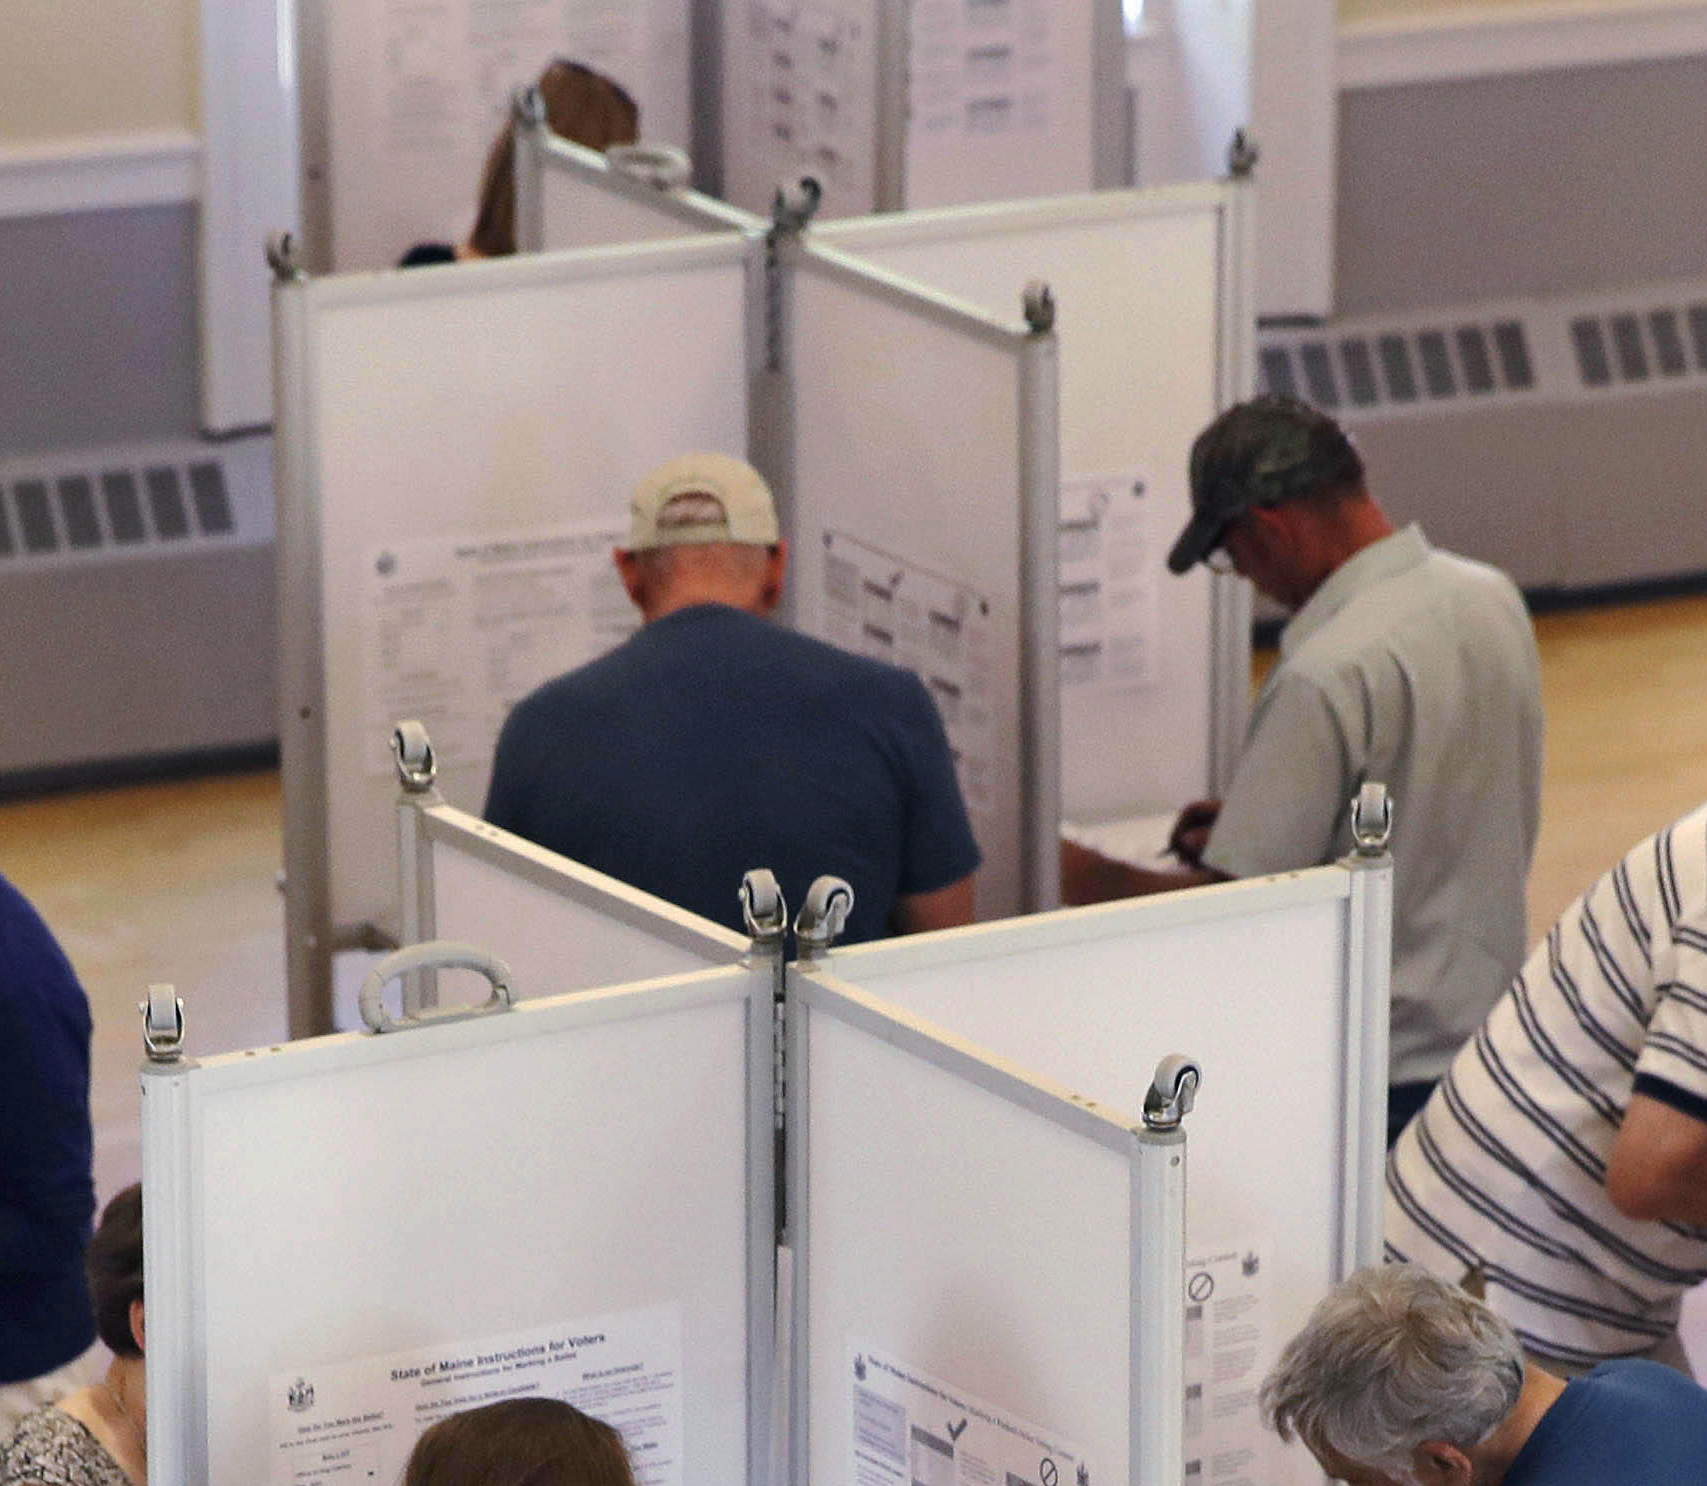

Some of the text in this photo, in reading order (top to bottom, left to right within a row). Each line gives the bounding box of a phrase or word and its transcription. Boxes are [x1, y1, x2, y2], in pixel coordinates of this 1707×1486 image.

[390, 1333, 606, 1381] State of Maine Instructions for Voters
